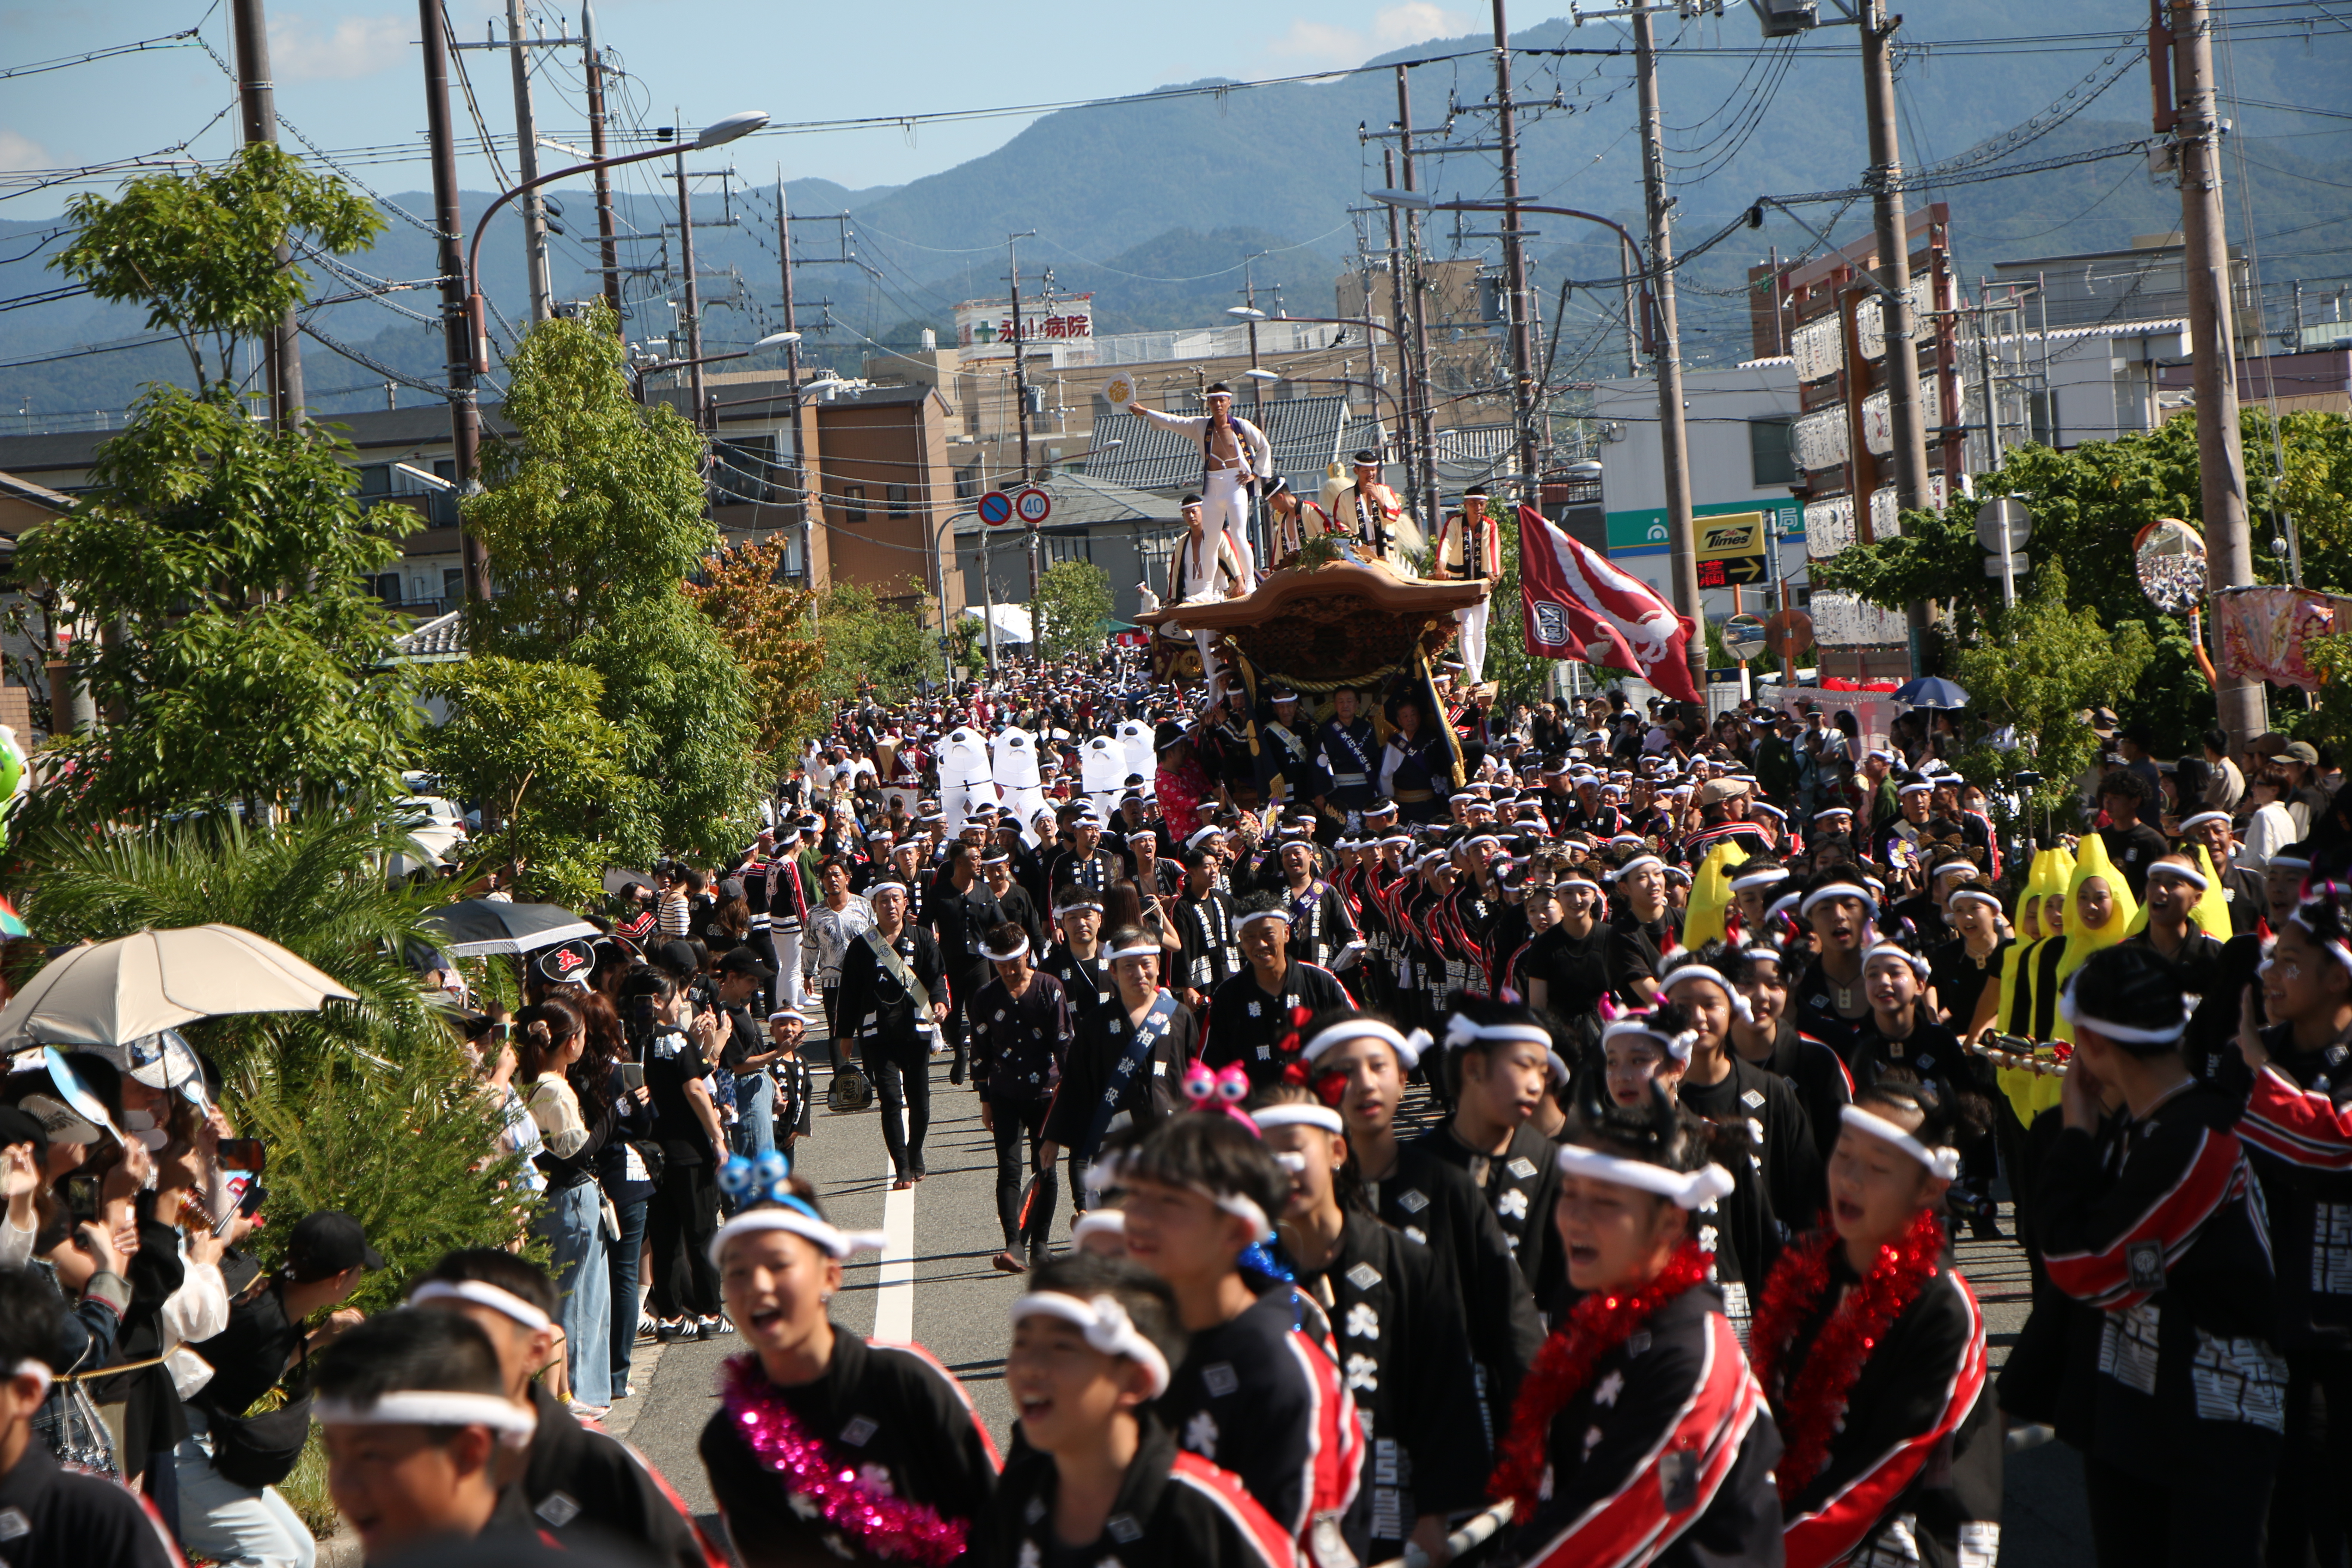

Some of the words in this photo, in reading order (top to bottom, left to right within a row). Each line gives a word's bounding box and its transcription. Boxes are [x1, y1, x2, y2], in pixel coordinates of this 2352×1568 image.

[1025, 498, 1043, 513] 40
[1708, 535, 1749, 548] Times
[1698, 560, 1725, 587] 満
[1105, 1026, 1155, 1107] 相談役
